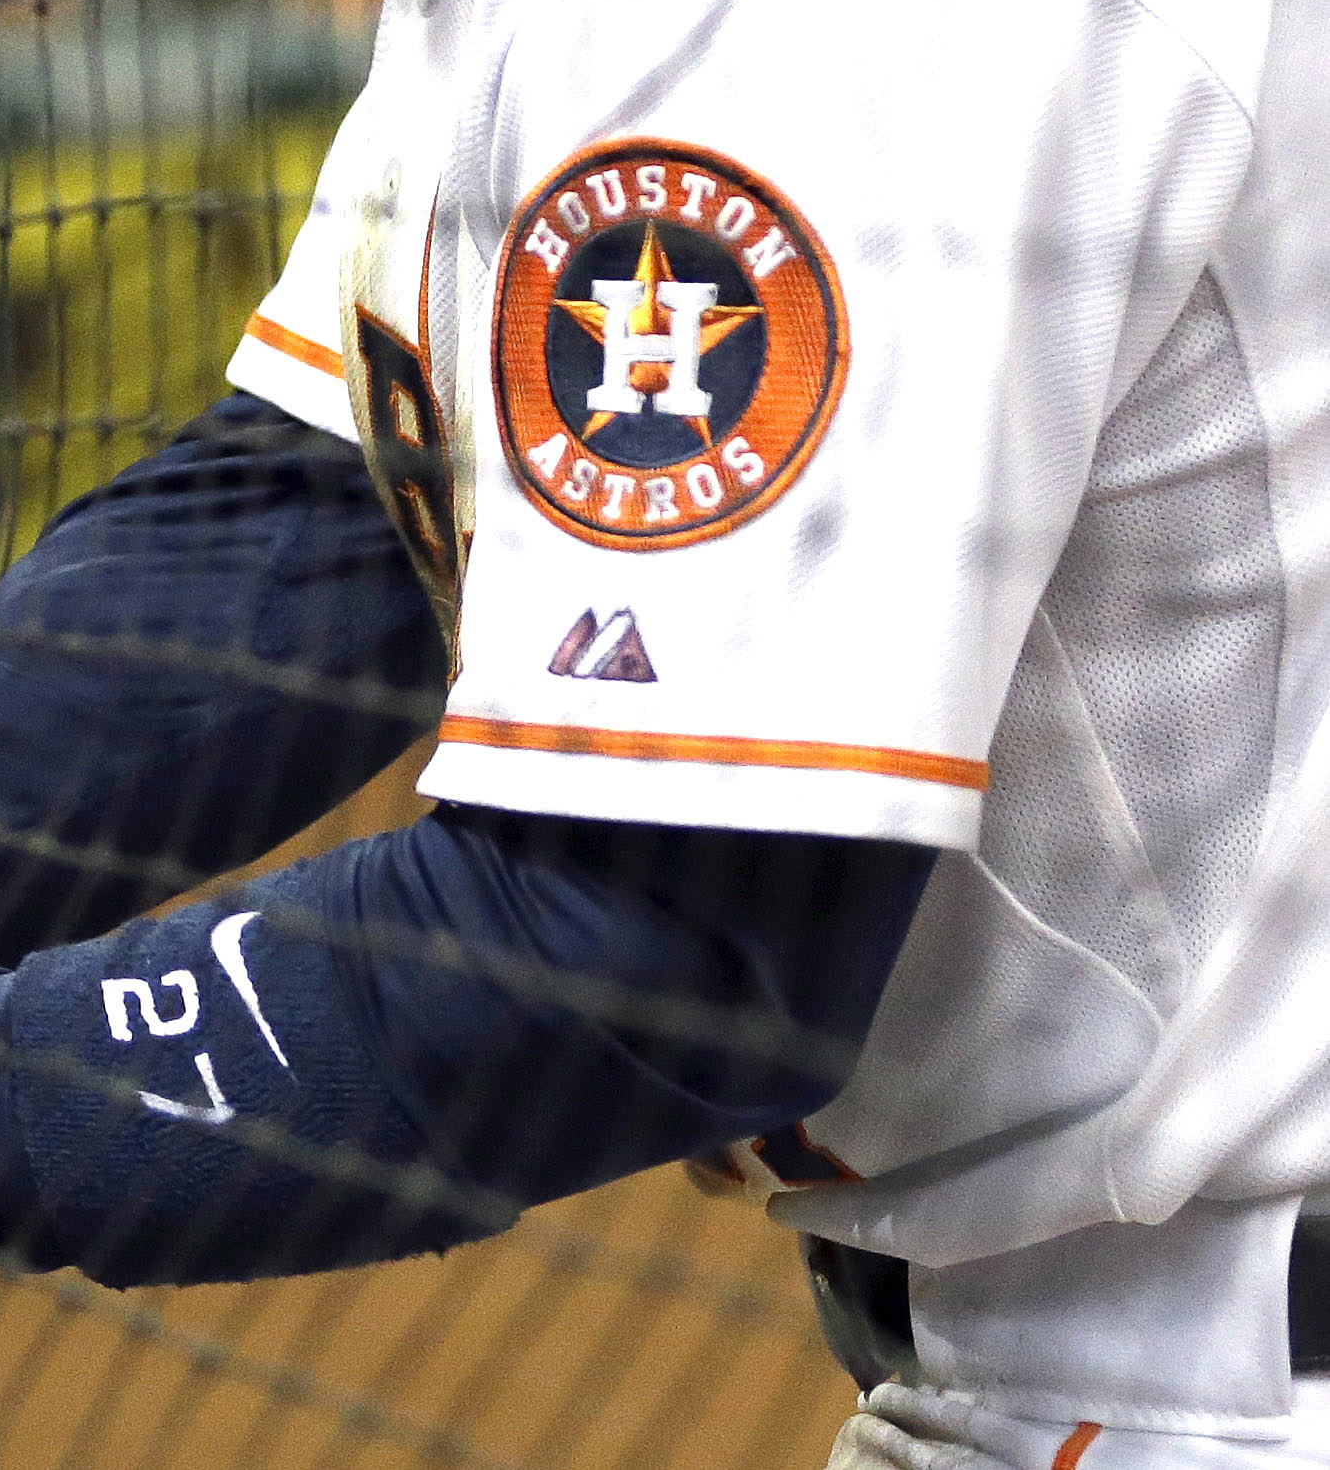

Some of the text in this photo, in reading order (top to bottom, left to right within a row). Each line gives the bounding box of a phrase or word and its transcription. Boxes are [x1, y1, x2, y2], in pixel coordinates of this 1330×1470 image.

[525, 164, 799, 278] HOUSTON
[586, 278, 718, 418] H
[527, 432, 765, 522] ASTROS
[100, 969, 237, 1125] 27
